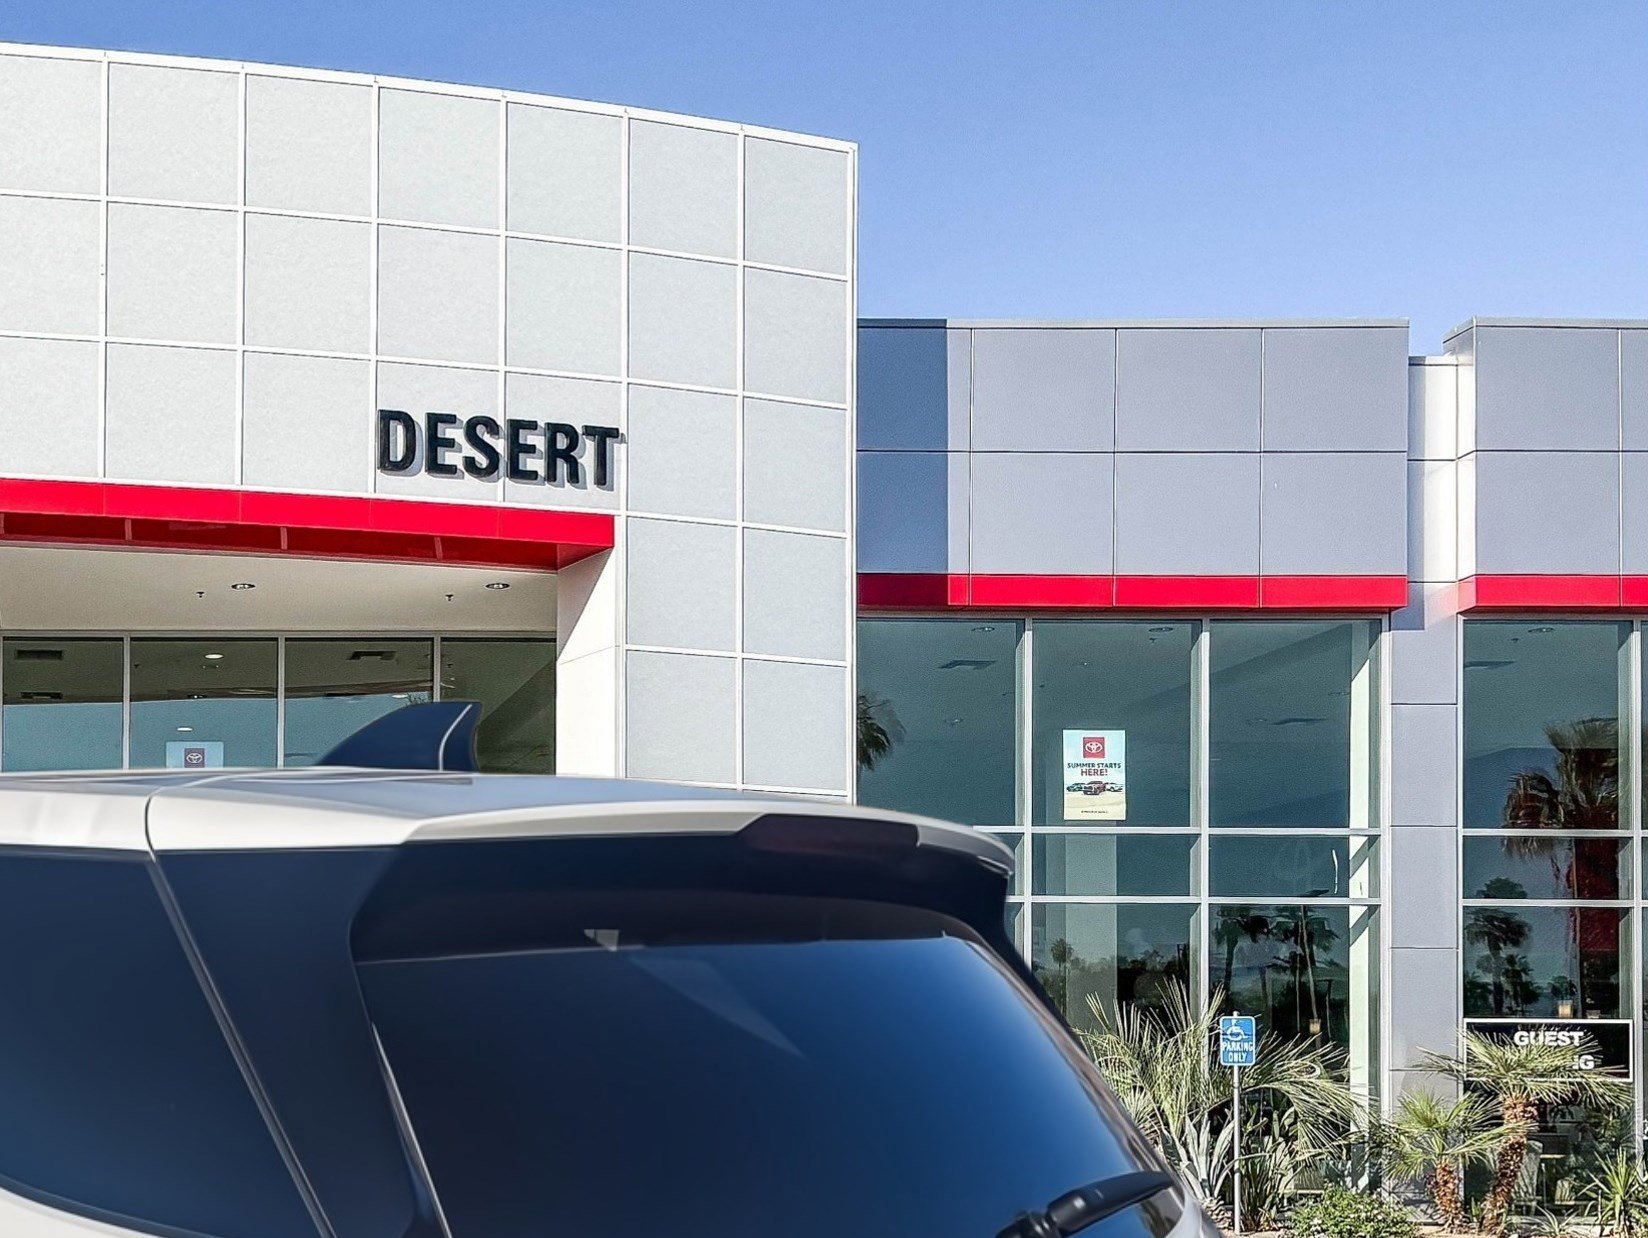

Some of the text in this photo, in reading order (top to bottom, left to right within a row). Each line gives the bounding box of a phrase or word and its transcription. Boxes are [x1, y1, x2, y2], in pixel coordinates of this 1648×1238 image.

[377, 409, 620, 486] DESERT
[1080, 768, 1108, 776] HERE!
[1513, 1031, 1585, 1047] GUEST
[1222, 1041, 1254, 1051] PARKING
[1228, 1052, 1247, 1062] ONLY
